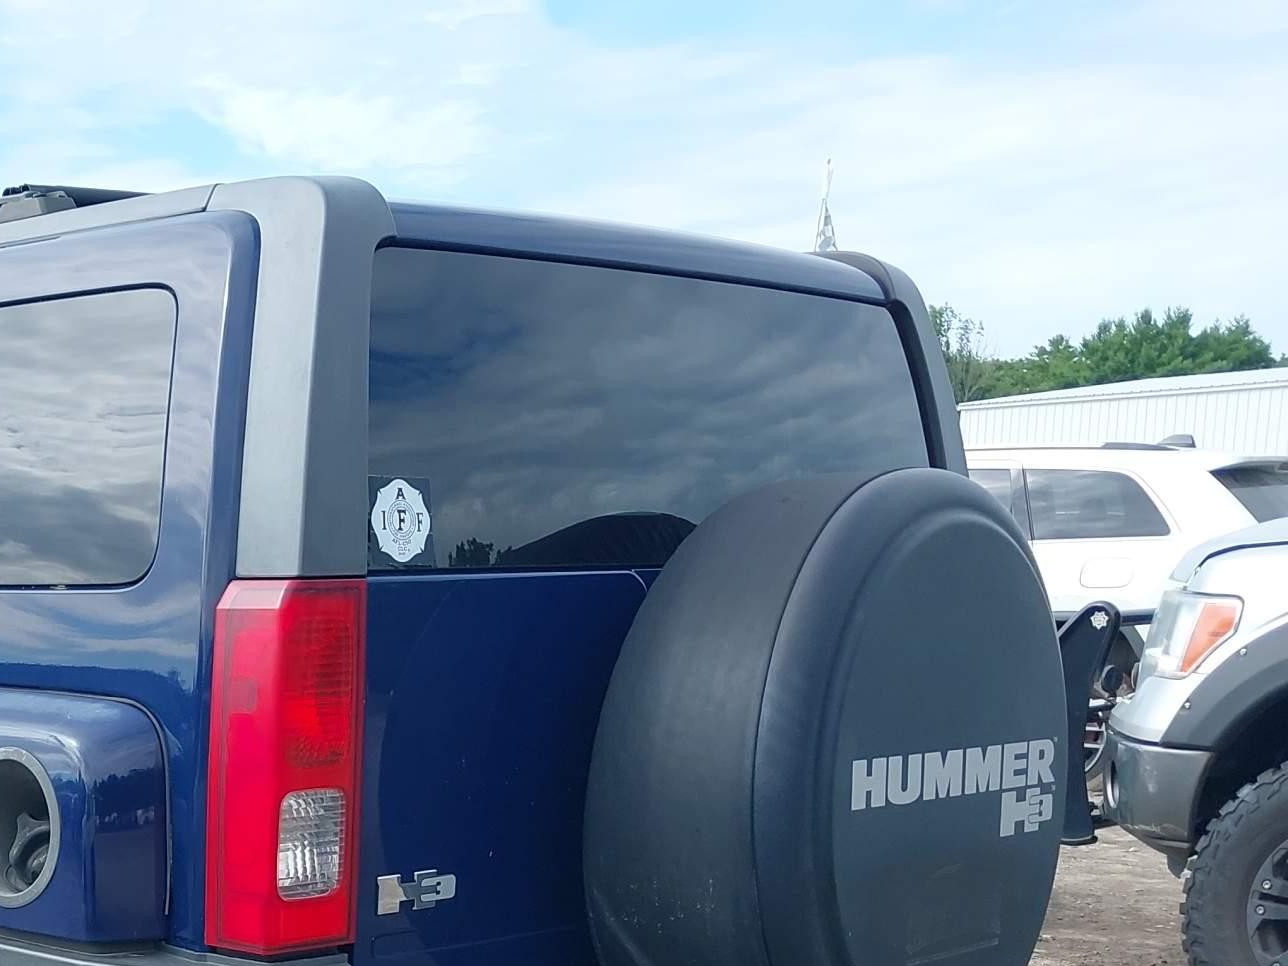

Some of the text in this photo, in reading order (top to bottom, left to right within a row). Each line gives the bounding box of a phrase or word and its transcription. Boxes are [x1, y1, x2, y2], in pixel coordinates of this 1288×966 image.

[851, 739, 1055, 811] HUMMER
[999, 787, 1053, 837] H3
[377, 869, 456, 915] H3
